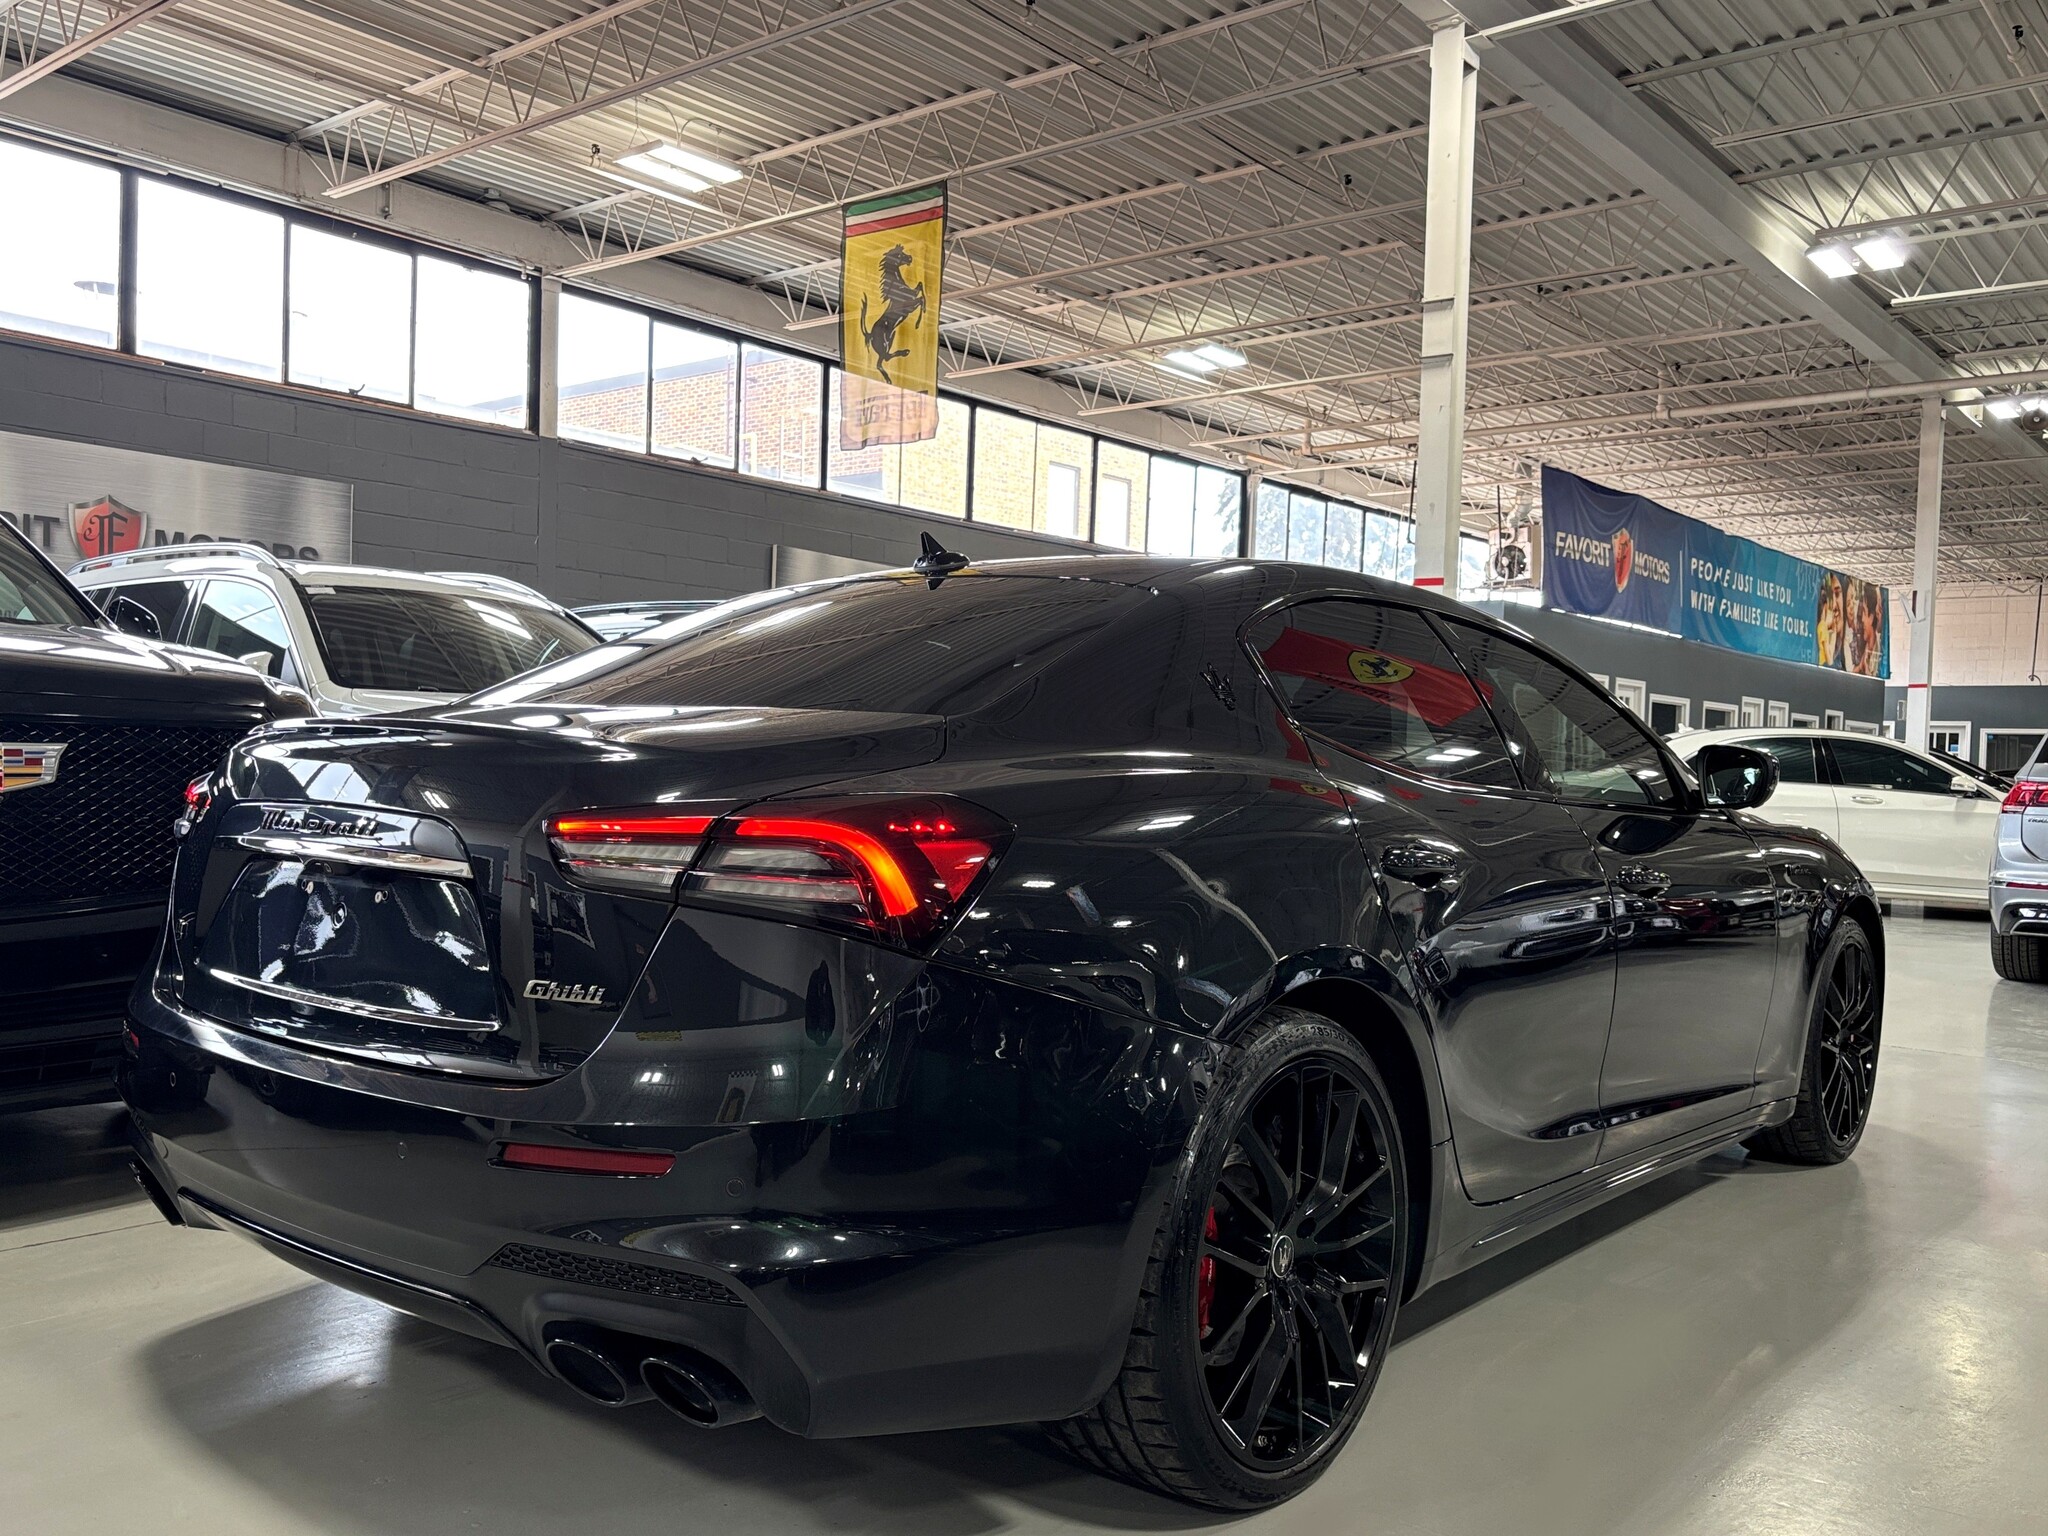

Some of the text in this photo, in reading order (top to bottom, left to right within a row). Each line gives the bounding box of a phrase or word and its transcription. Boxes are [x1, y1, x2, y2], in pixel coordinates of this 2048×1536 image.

[1555, 531, 1611, 567] FAVORIT
[1634, 551, 1670, 584] MOTORS
[1732, 572, 1753, 594] JUST
[1757, 579, 1774, 600] LIKE
[1690, 590, 1812, 638] WITH FAMILIES LIKE YOURS.
[262, 810, 379, 837] Maserati
[523, 979, 608, 1004] Ghibli
